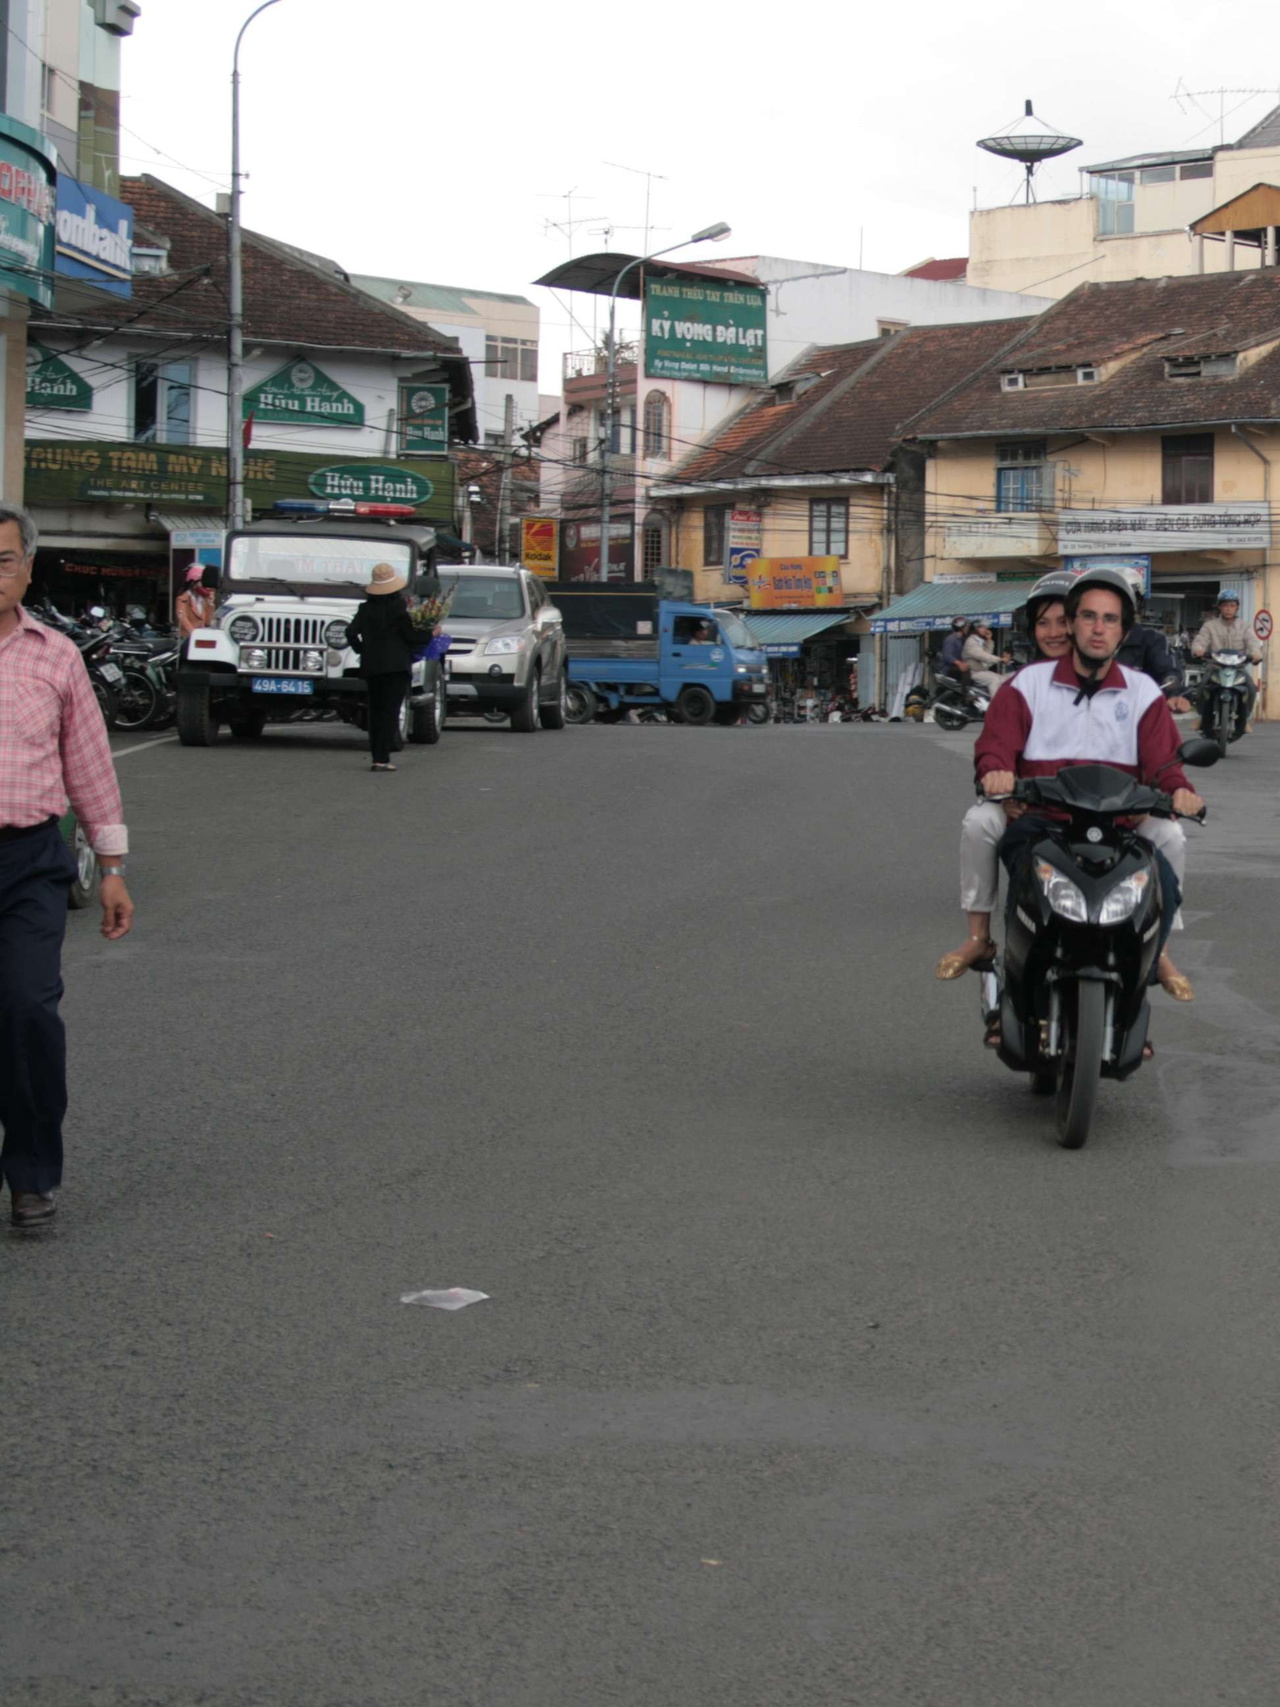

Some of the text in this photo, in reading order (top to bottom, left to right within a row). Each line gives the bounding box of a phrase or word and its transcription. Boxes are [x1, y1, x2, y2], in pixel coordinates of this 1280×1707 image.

[674, 320, 713, 347] VỌNG
[259, 393, 354, 415] Hữu Hạnh
[325, 470, 418, 502] Hữu Hạnh
[525, 551, 552, 561] Kodak
